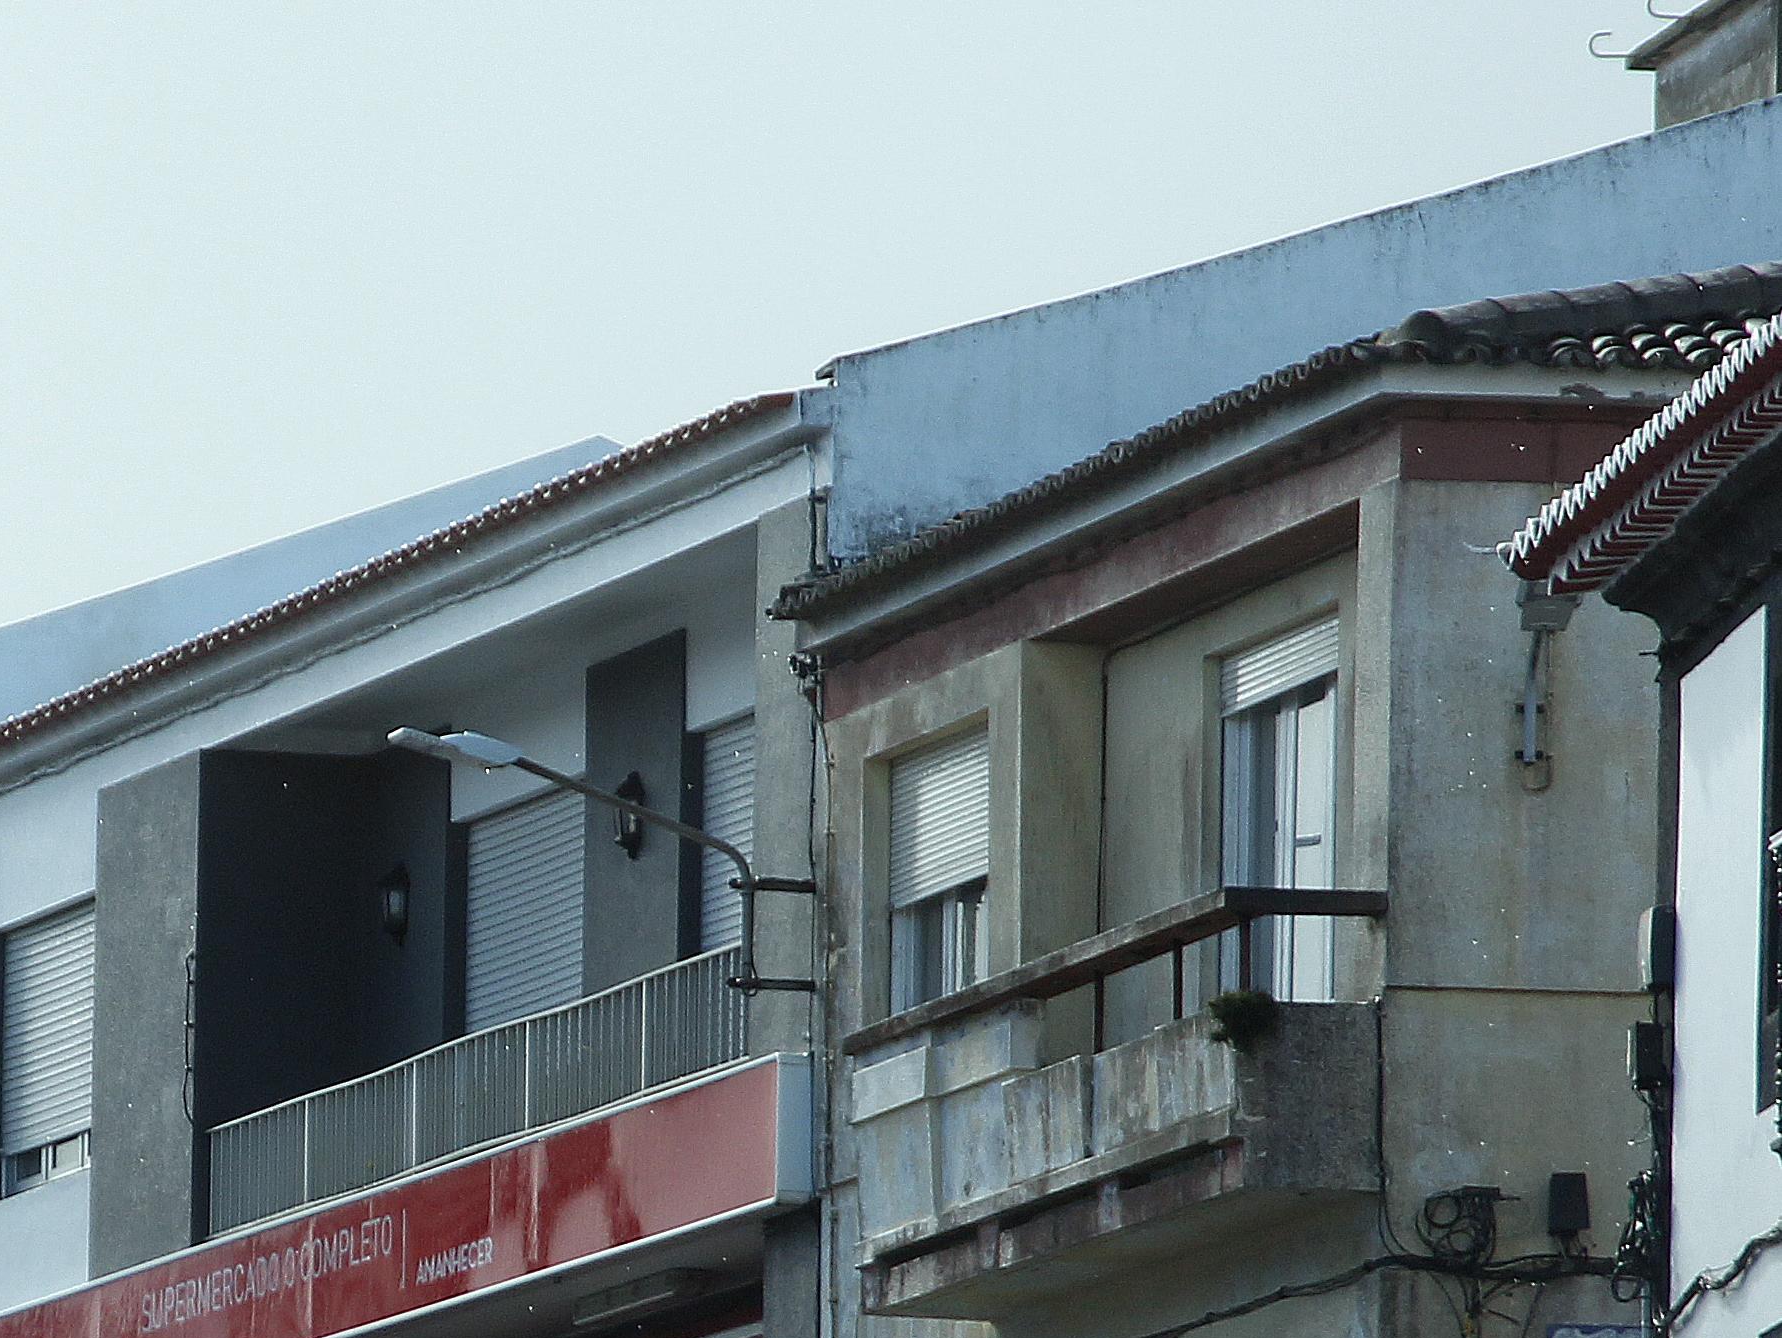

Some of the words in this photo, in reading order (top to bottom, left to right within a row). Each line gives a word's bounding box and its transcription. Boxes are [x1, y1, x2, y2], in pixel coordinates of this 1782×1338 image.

[142, 1252, 280, 1332] SUPERMERCADO
[300, 1214, 393, 1281] COMPLETO
[416, 1236, 493, 1286] AMANHECER
